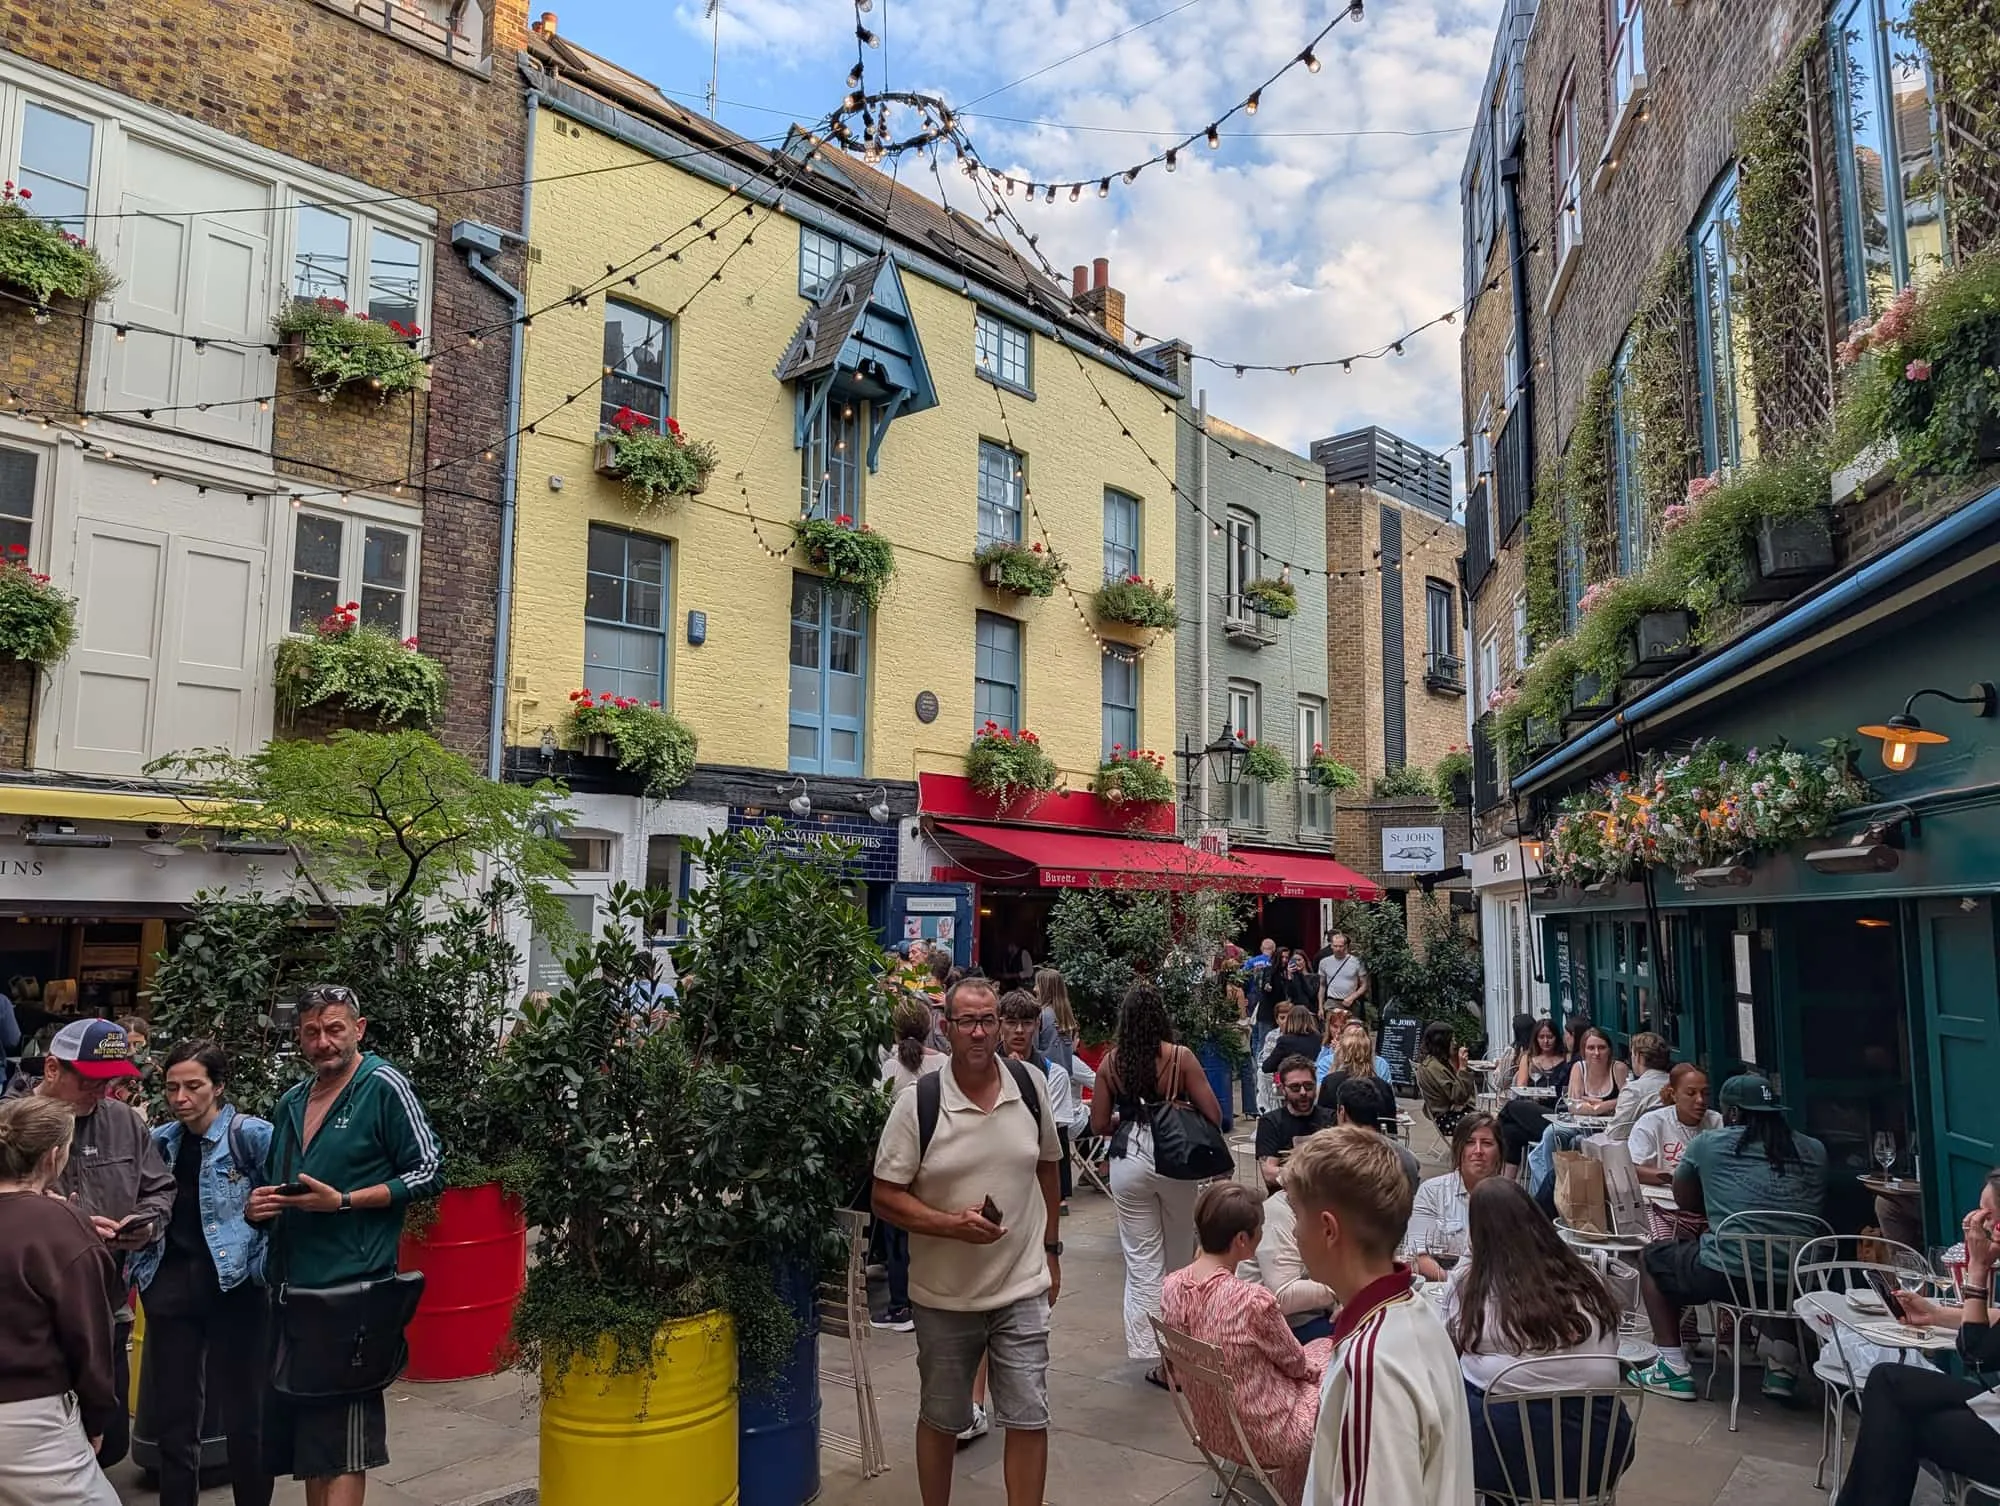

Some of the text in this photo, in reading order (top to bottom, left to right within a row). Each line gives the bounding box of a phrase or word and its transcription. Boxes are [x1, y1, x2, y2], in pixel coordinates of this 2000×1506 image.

[793, 829, 823, 843] YARD
[1405, 832, 1434, 842] JOHN
[0, 860, 43, 876] INS
[1045, 871, 1076, 883] Buvette
